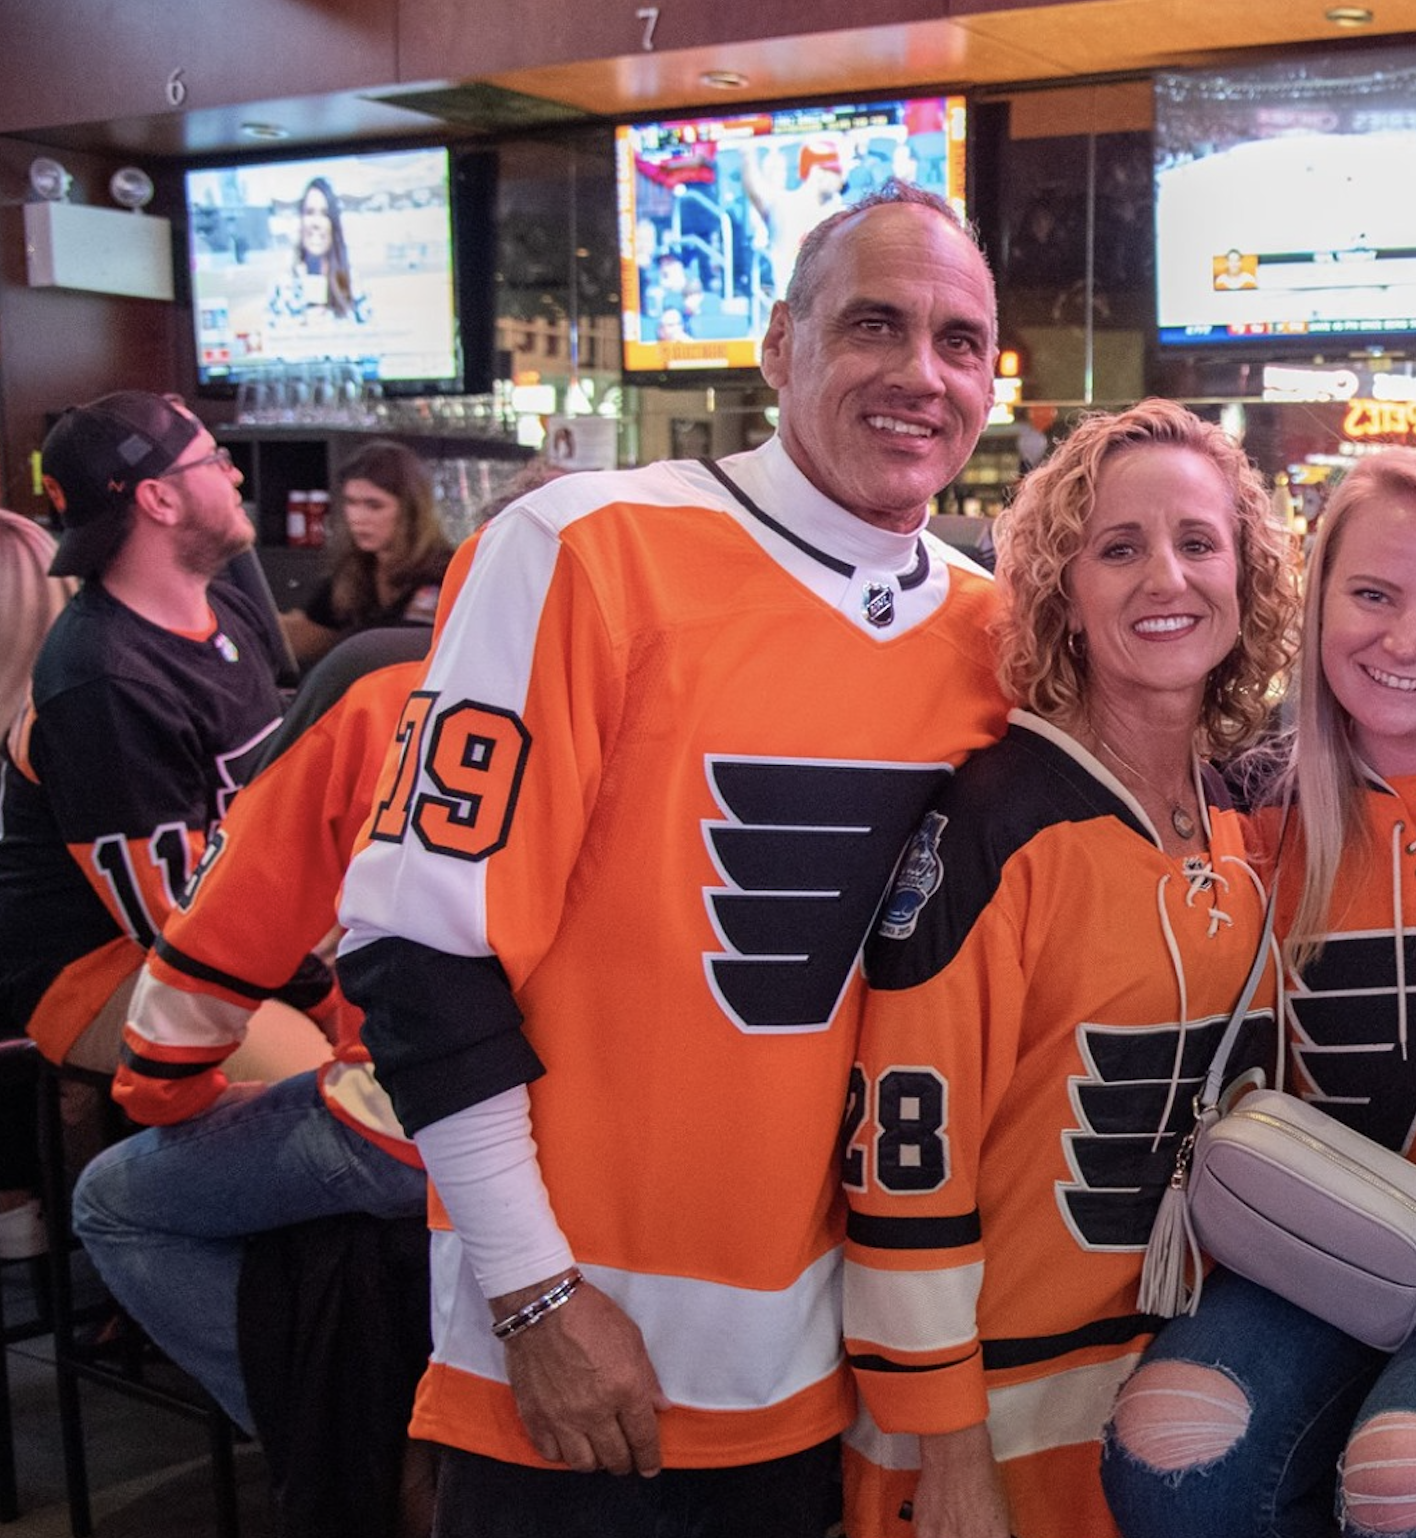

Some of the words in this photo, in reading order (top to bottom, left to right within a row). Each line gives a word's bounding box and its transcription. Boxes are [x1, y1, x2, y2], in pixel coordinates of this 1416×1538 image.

[636, 7, 659, 50] 7
[165, 67, 186, 105] 6
[368, 690, 533, 863] 79
[841, 1062, 952, 1196] 28
